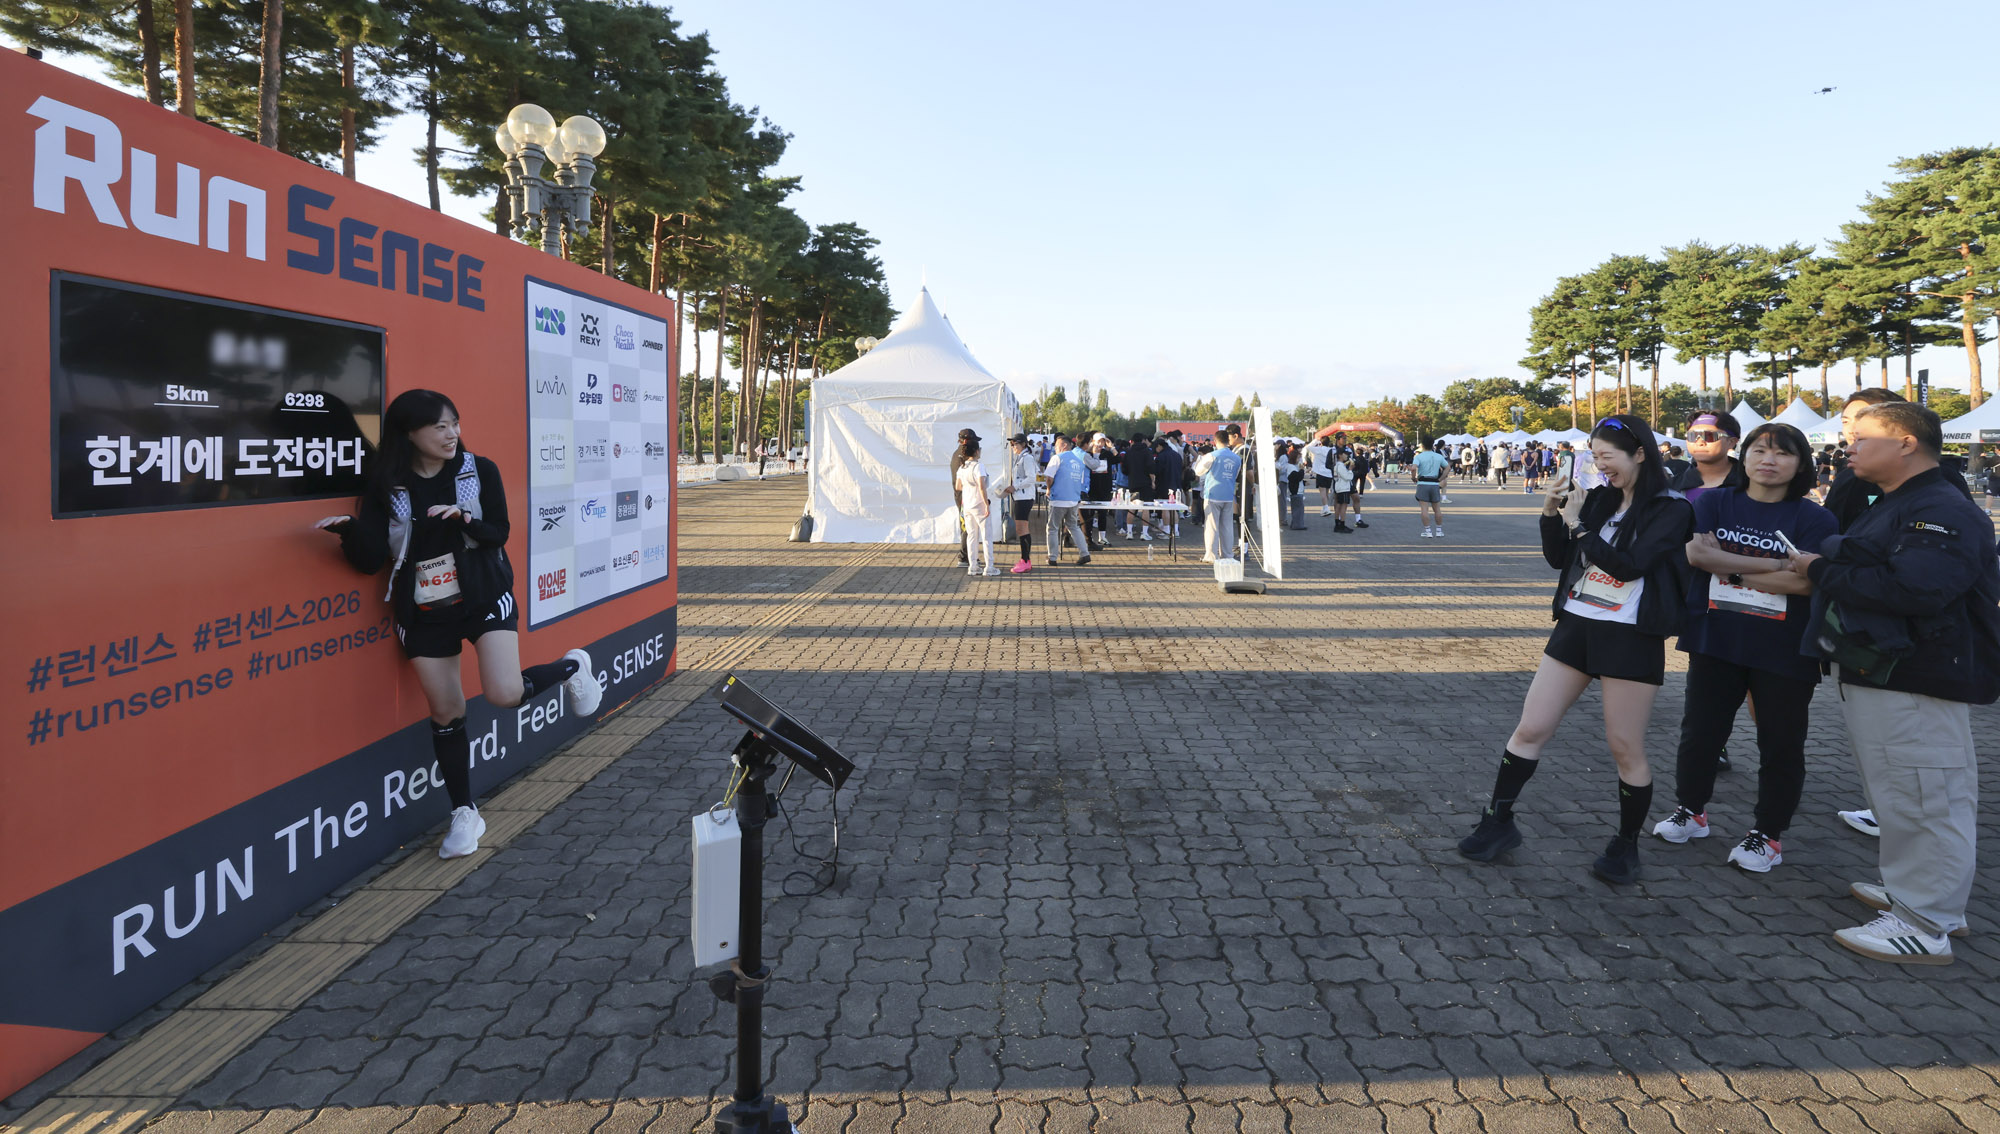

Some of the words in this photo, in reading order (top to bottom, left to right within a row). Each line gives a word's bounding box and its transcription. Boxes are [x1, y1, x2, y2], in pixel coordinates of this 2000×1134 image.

[580, 335, 601, 347] REXY
[615, 324, 633, 338] Choco
[165, 384, 209, 402] 5km
[284, 393, 325, 408] 6298
[85, 434, 224, 486] 한계에
[234, 436, 366, 478] 도전하다
[539, 505, 567, 518] Reebok
[1588, 571, 1625, 588] 6299
[27, 632, 178, 694] #런센스
[192, 590, 361, 654] #런센스2026
[27, 667, 234, 747] #runsense
[111, 845, 254, 976] RUN
[274, 800, 368, 874] The
[384, 719, 507, 818] Recrd,
[517, 685, 564, 743] Feel
[613, 633, 664, 684] SENSE
